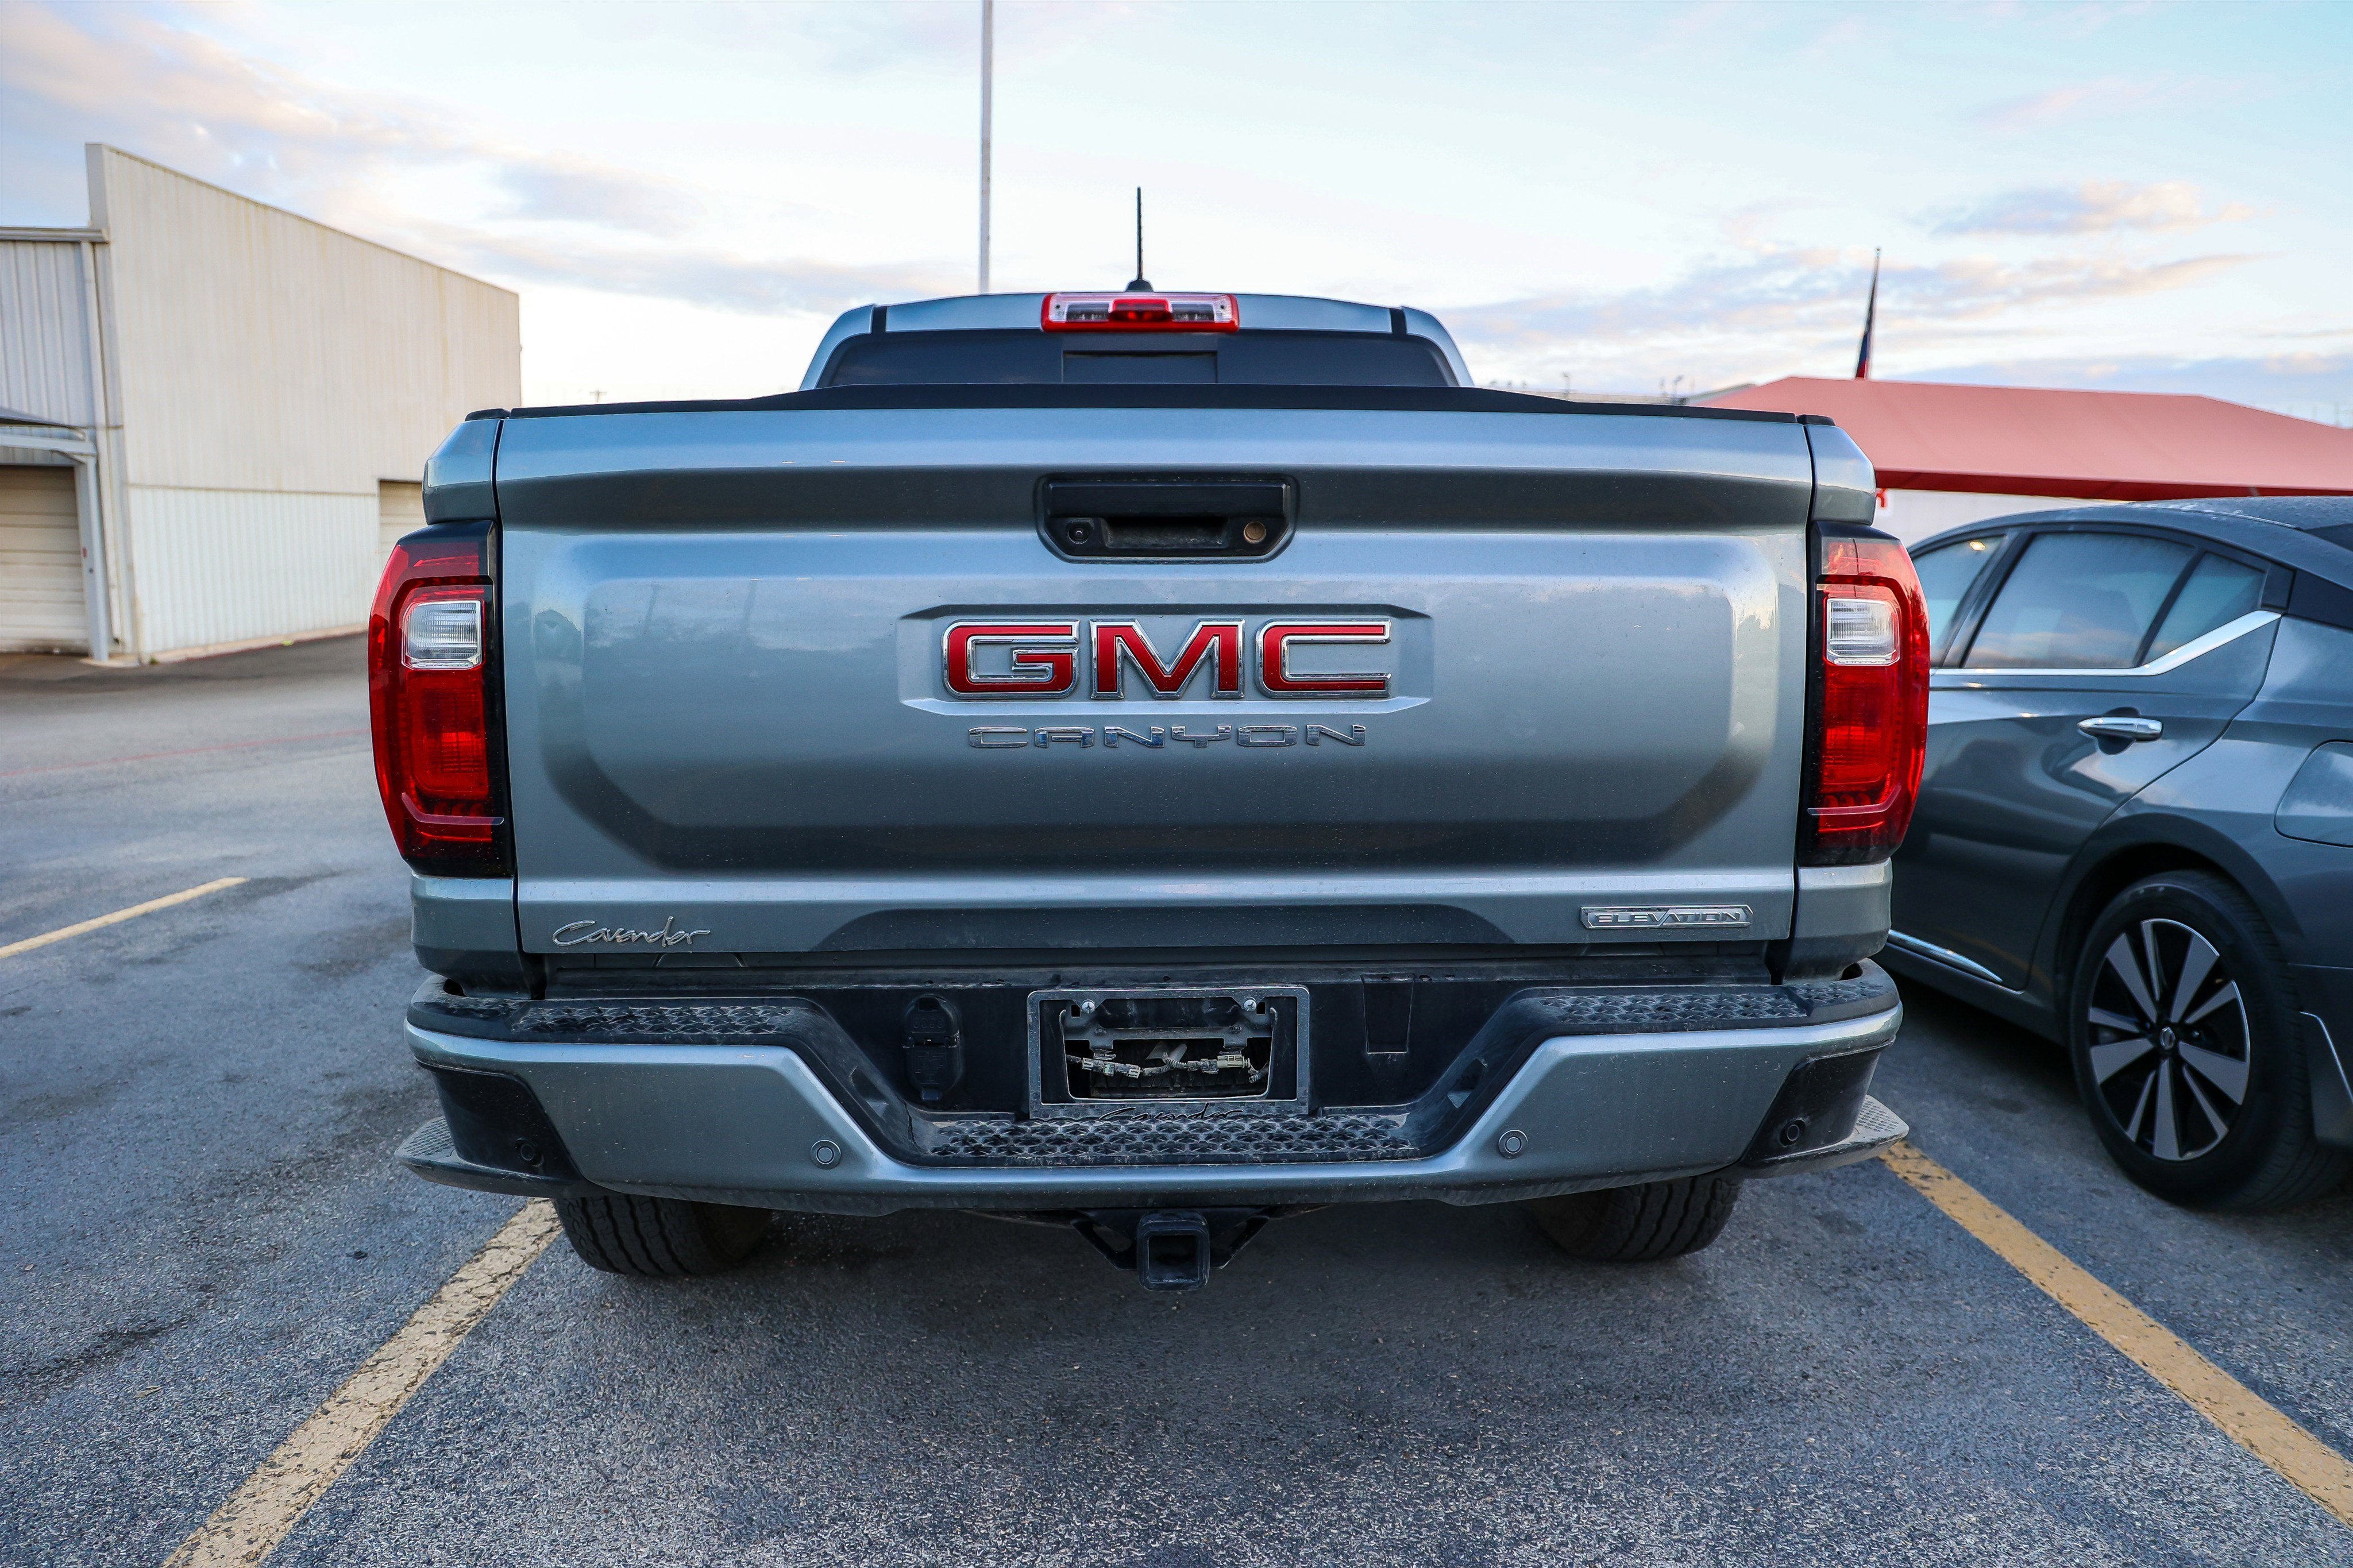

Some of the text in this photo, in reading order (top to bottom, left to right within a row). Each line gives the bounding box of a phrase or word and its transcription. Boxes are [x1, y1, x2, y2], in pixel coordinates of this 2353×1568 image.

[941, 617, 1392, 700] GMC
[968, 724, 1366, 748] CANYON
[1595, 910, 1742, 922] ELEVATION
[553, 916, 712, 948] Cavender
